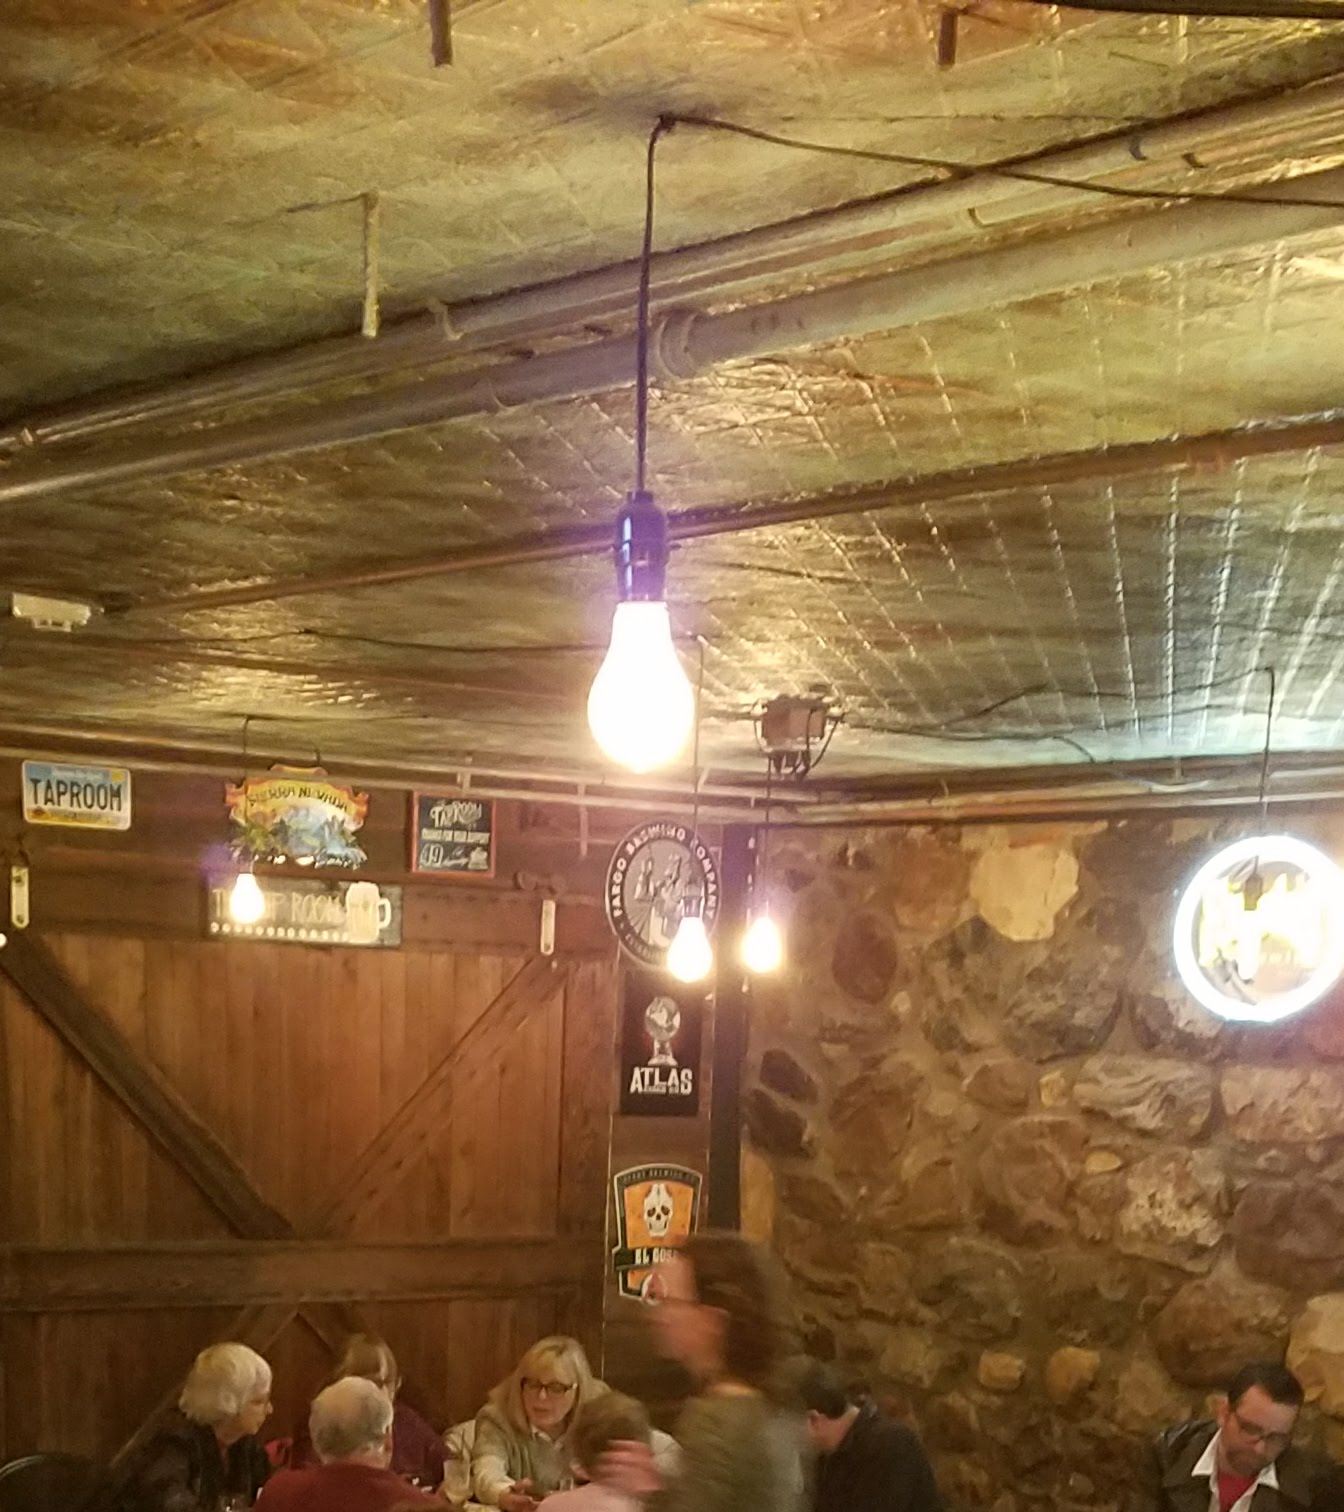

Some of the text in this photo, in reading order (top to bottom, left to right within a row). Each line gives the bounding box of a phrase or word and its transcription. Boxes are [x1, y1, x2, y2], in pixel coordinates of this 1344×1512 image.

[30, 778, 122, 812] TAPROOM
[611, 824, 717, 920] FARGO BREWING COMPANY
[630, 1066, 693, 1095] ATLAS
